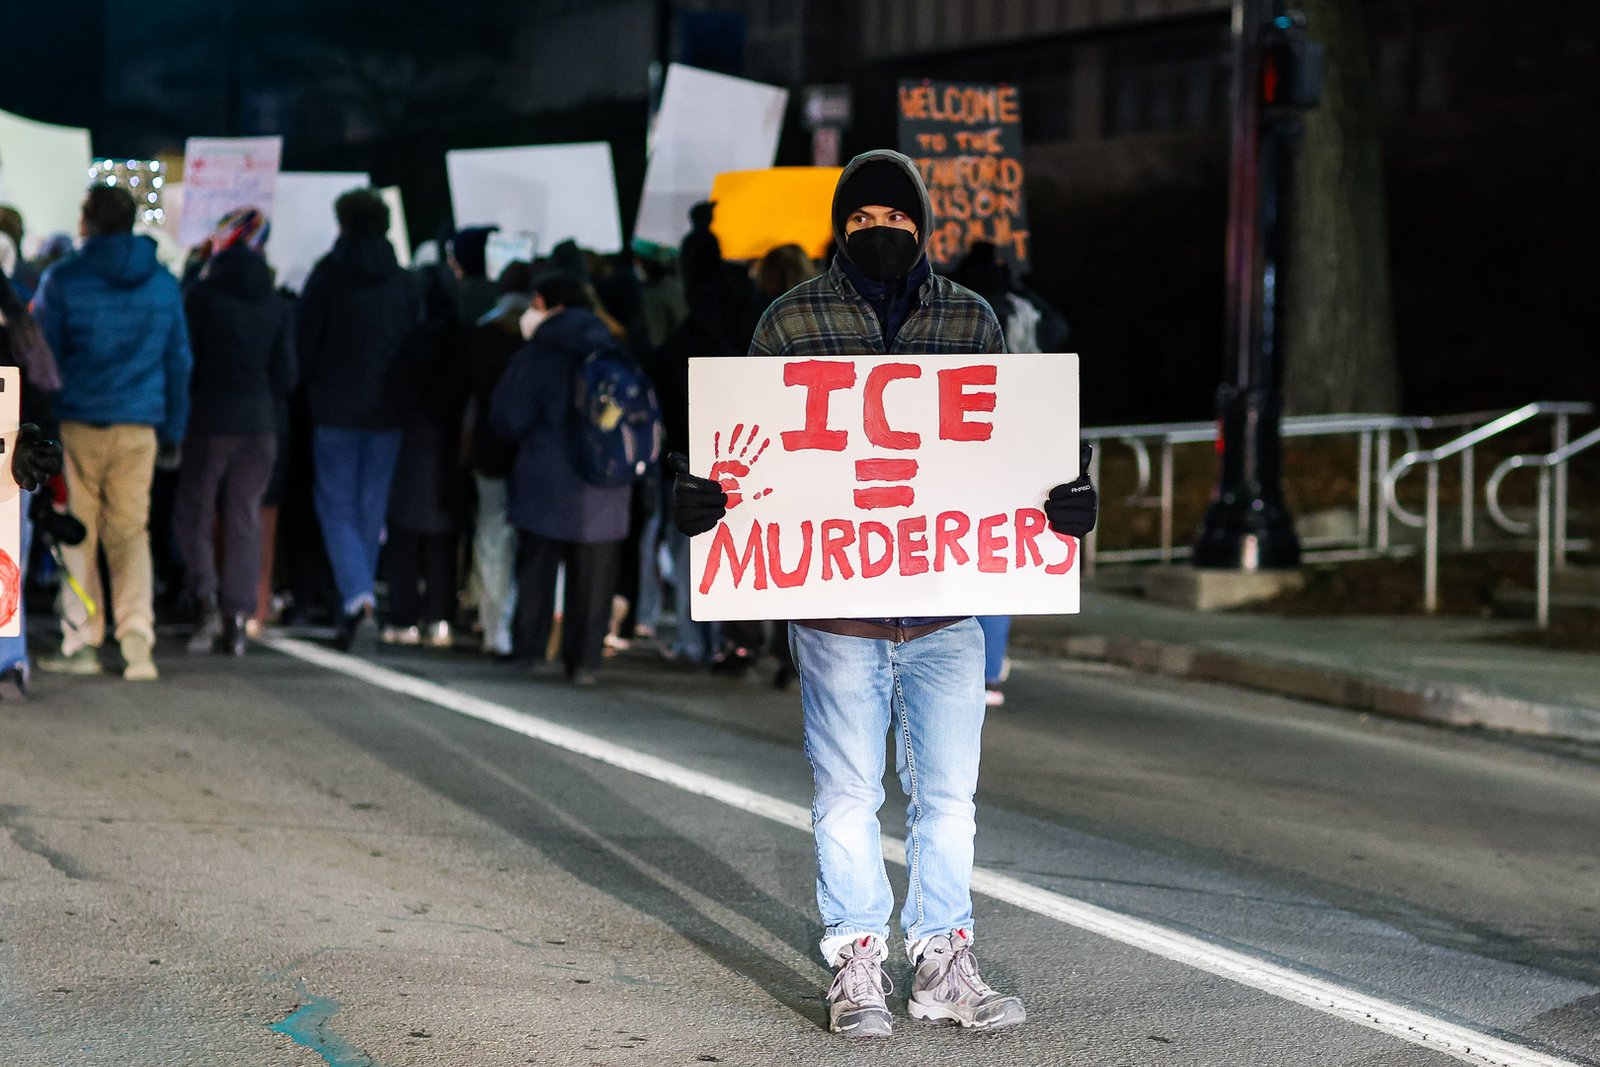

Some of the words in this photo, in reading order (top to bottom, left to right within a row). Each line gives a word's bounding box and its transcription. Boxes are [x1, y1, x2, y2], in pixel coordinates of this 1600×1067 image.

[899, 86, 1020, 124] WELCOME
[916, 132, 948, 152] TO
[954, 128, 1004, 153] THE
[781, 360, 996, 451] ICE
[700, 508, 1077, 595] MURDERERS
